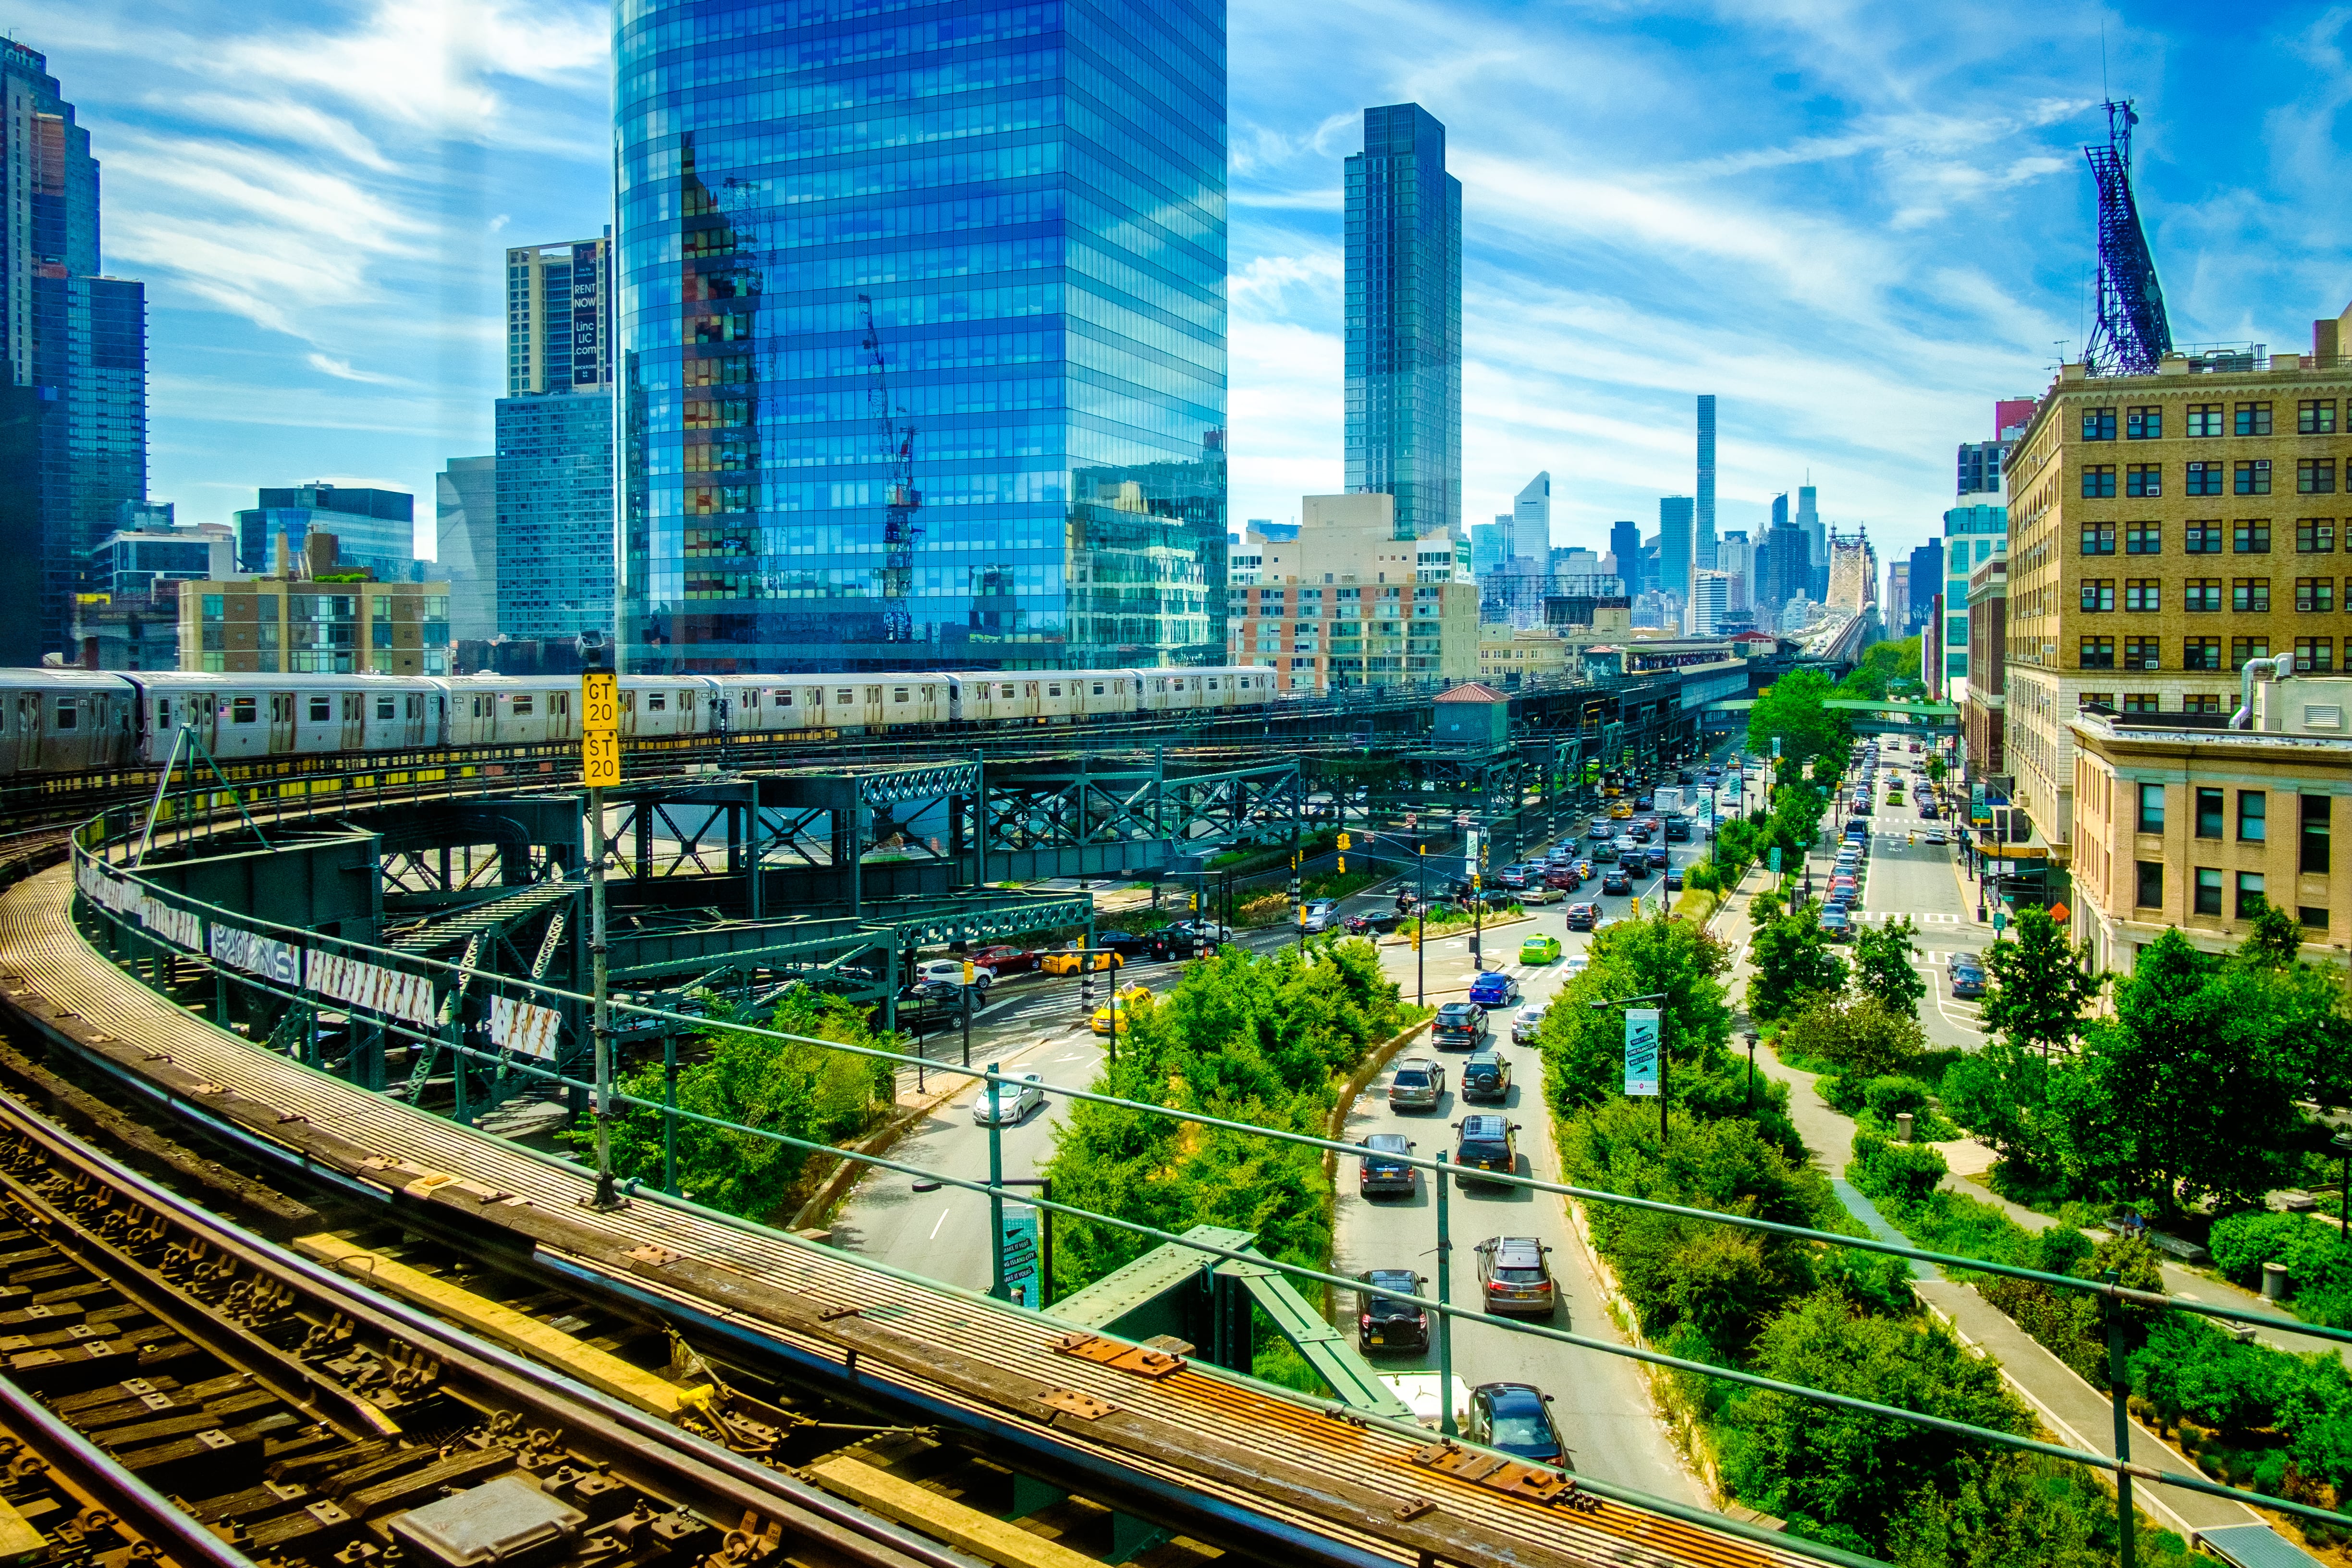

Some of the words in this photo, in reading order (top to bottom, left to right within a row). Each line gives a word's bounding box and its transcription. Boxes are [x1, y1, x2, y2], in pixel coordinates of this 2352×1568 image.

[575, 283, 596, 294] RENT
[575, 297, 596, 308] NOW
[576, 321, 594, 331] Linc
[578, 333, 592, 343] LIC
[575, 346, 596, 355] .com
[589, 683, 611, 700] GT
[589, 703, 612, 721] 20
[589, 739, 612, 756] ST
[590, 760, 613, 777] 20
[1019, 1239, 1029, 1248] HERE
[1010, 1256, 1026, 1265] ISLAND
[1018, 1268, 1031, 1277] YOURS
